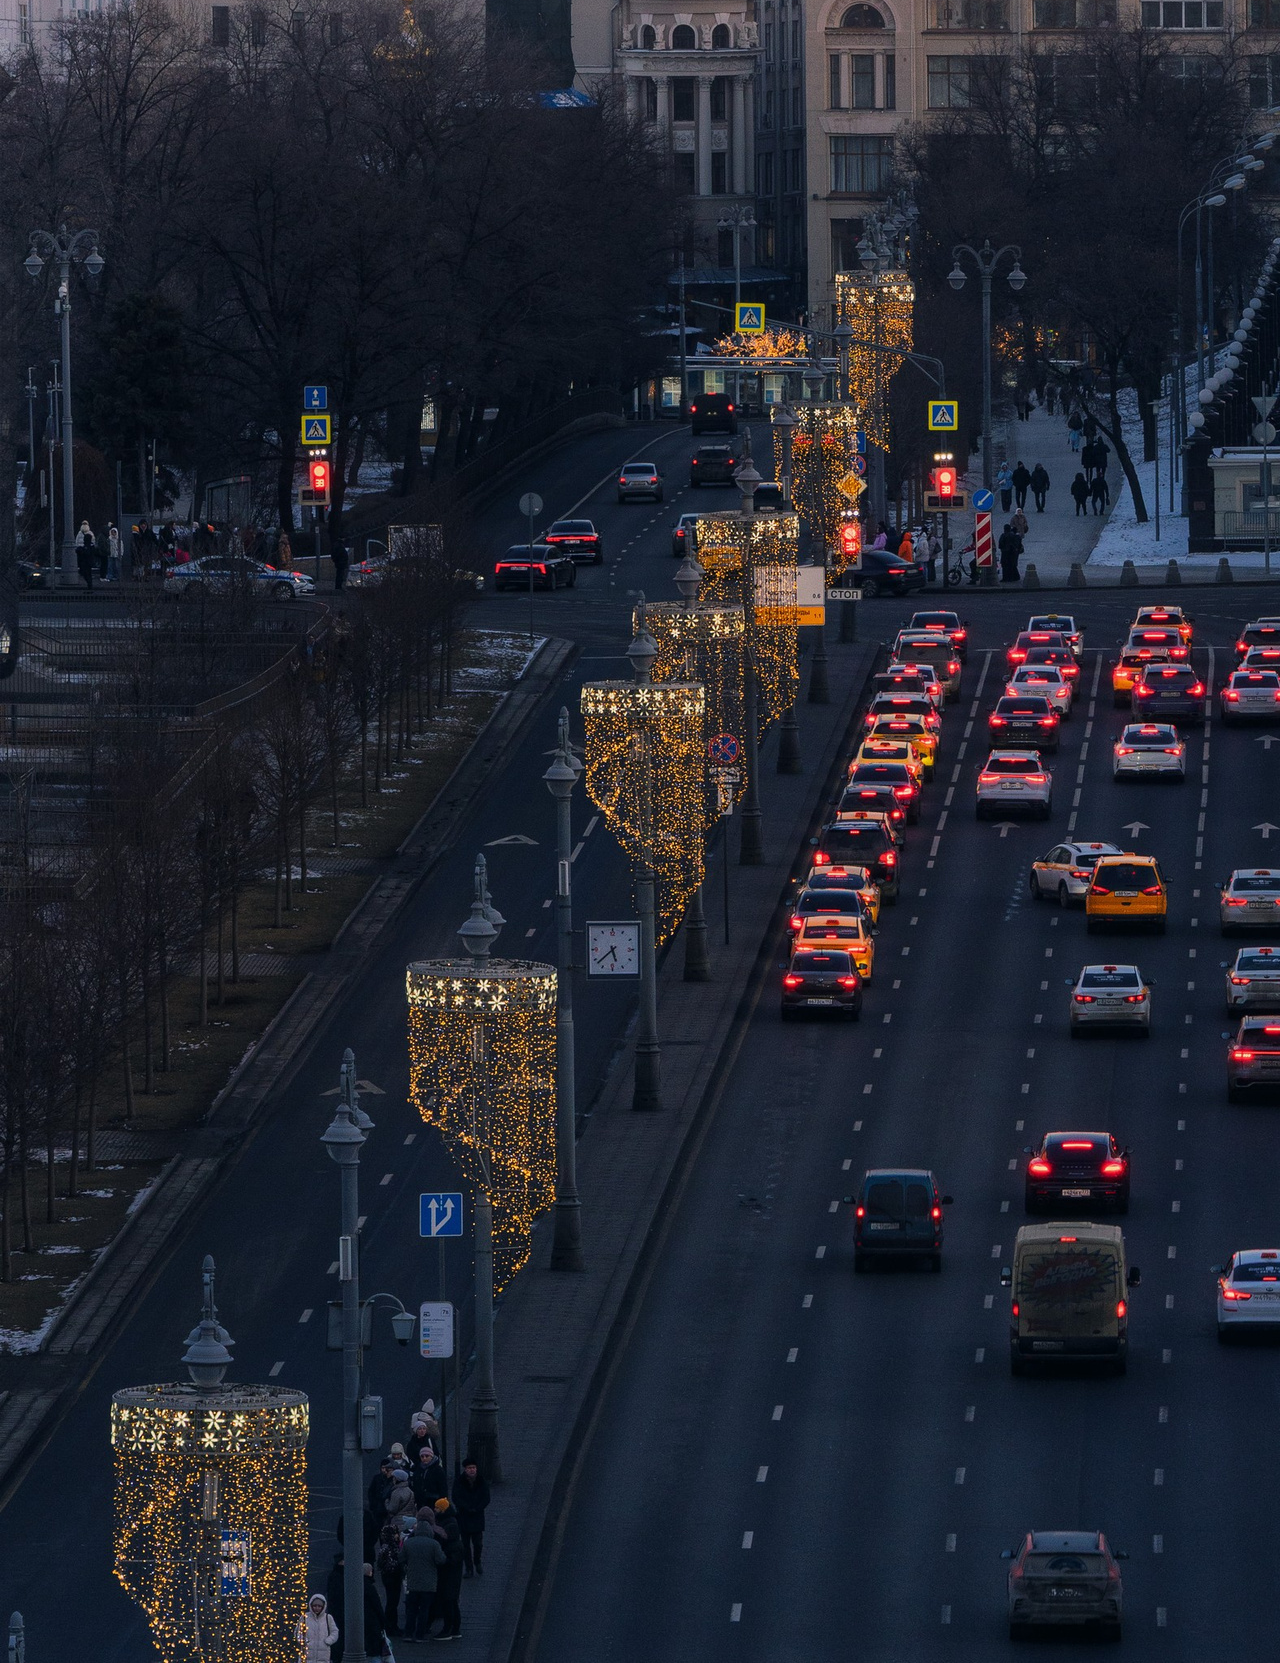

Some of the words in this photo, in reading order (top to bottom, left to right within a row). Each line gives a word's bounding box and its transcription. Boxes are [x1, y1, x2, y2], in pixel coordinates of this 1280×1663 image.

[315, 478, 325, 488] 38
[941, 485, 951, 494] 38
[830, 590, 859, 599] СТОП
